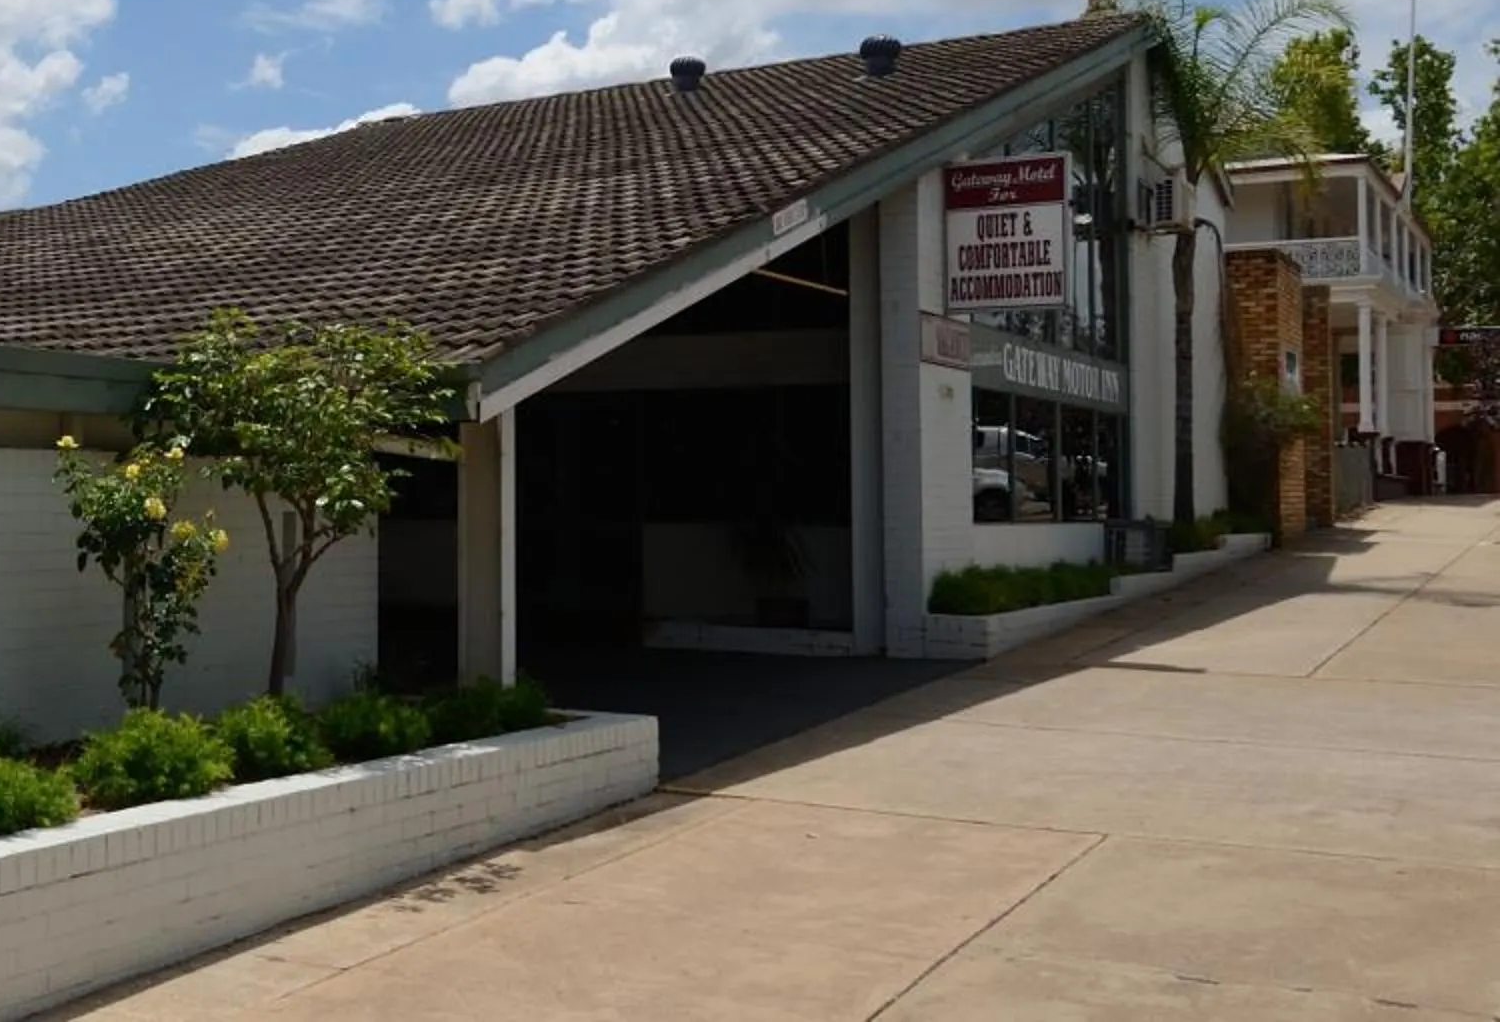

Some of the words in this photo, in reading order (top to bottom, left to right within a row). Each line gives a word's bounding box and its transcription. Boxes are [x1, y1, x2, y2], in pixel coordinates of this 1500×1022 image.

[951, 170, 1012, 193] Gateway
[1014, 162, 1057, 182] Motel
[976, 212, 1018, 242] QUIET
[1023, 211, 1033, 237] &
[958, 240, 1051, 271] COMFORTABLE
[950, 270, 1064, 302] ACCOMMODATION
[1003, 342, 1060, 390] GATEWAY
[1062, 358, 1100, 401] MOTOR
